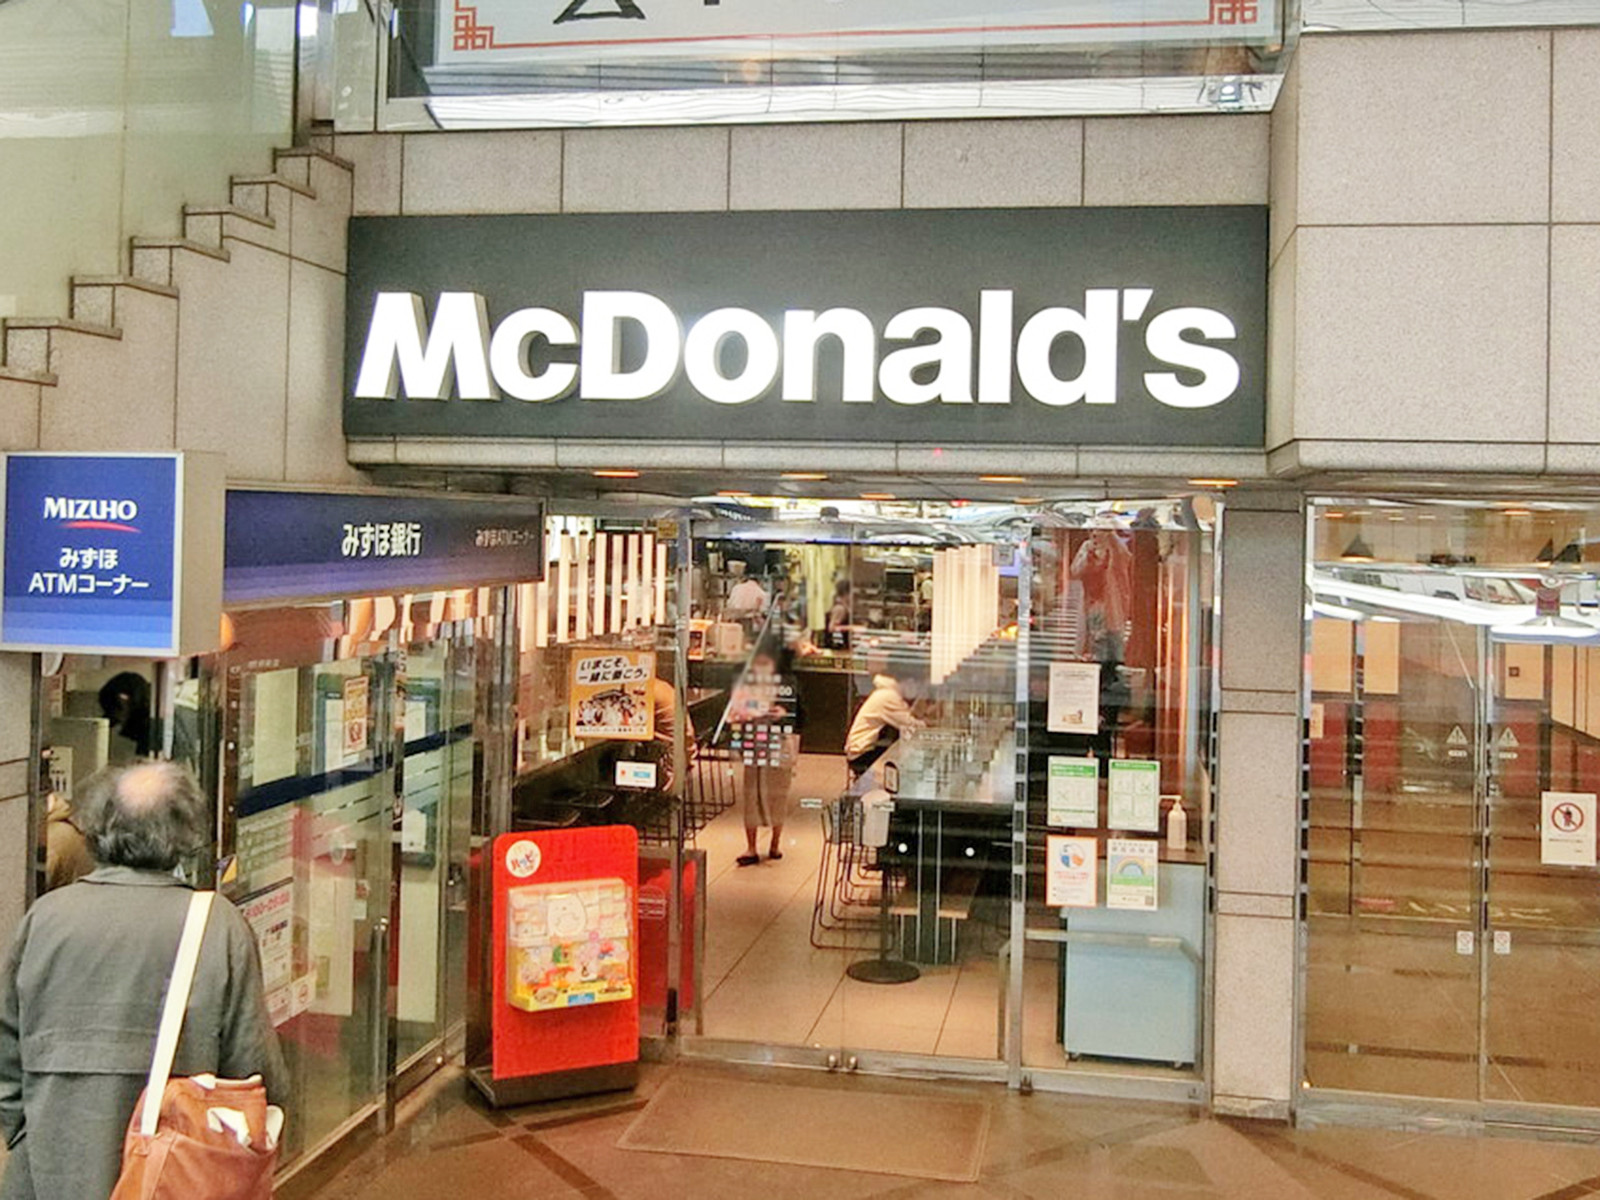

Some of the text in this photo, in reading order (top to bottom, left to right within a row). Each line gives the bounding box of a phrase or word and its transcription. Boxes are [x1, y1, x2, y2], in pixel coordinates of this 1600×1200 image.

[354, 287, 1241, 409] McDonald's
[43, 496, 138, 521] MIZUHO
[341, 522, 422, 557] みずほ銀行
[59, 547, 119, 570] みずほ
[28, 571, 150, 595] ATMコーナー
